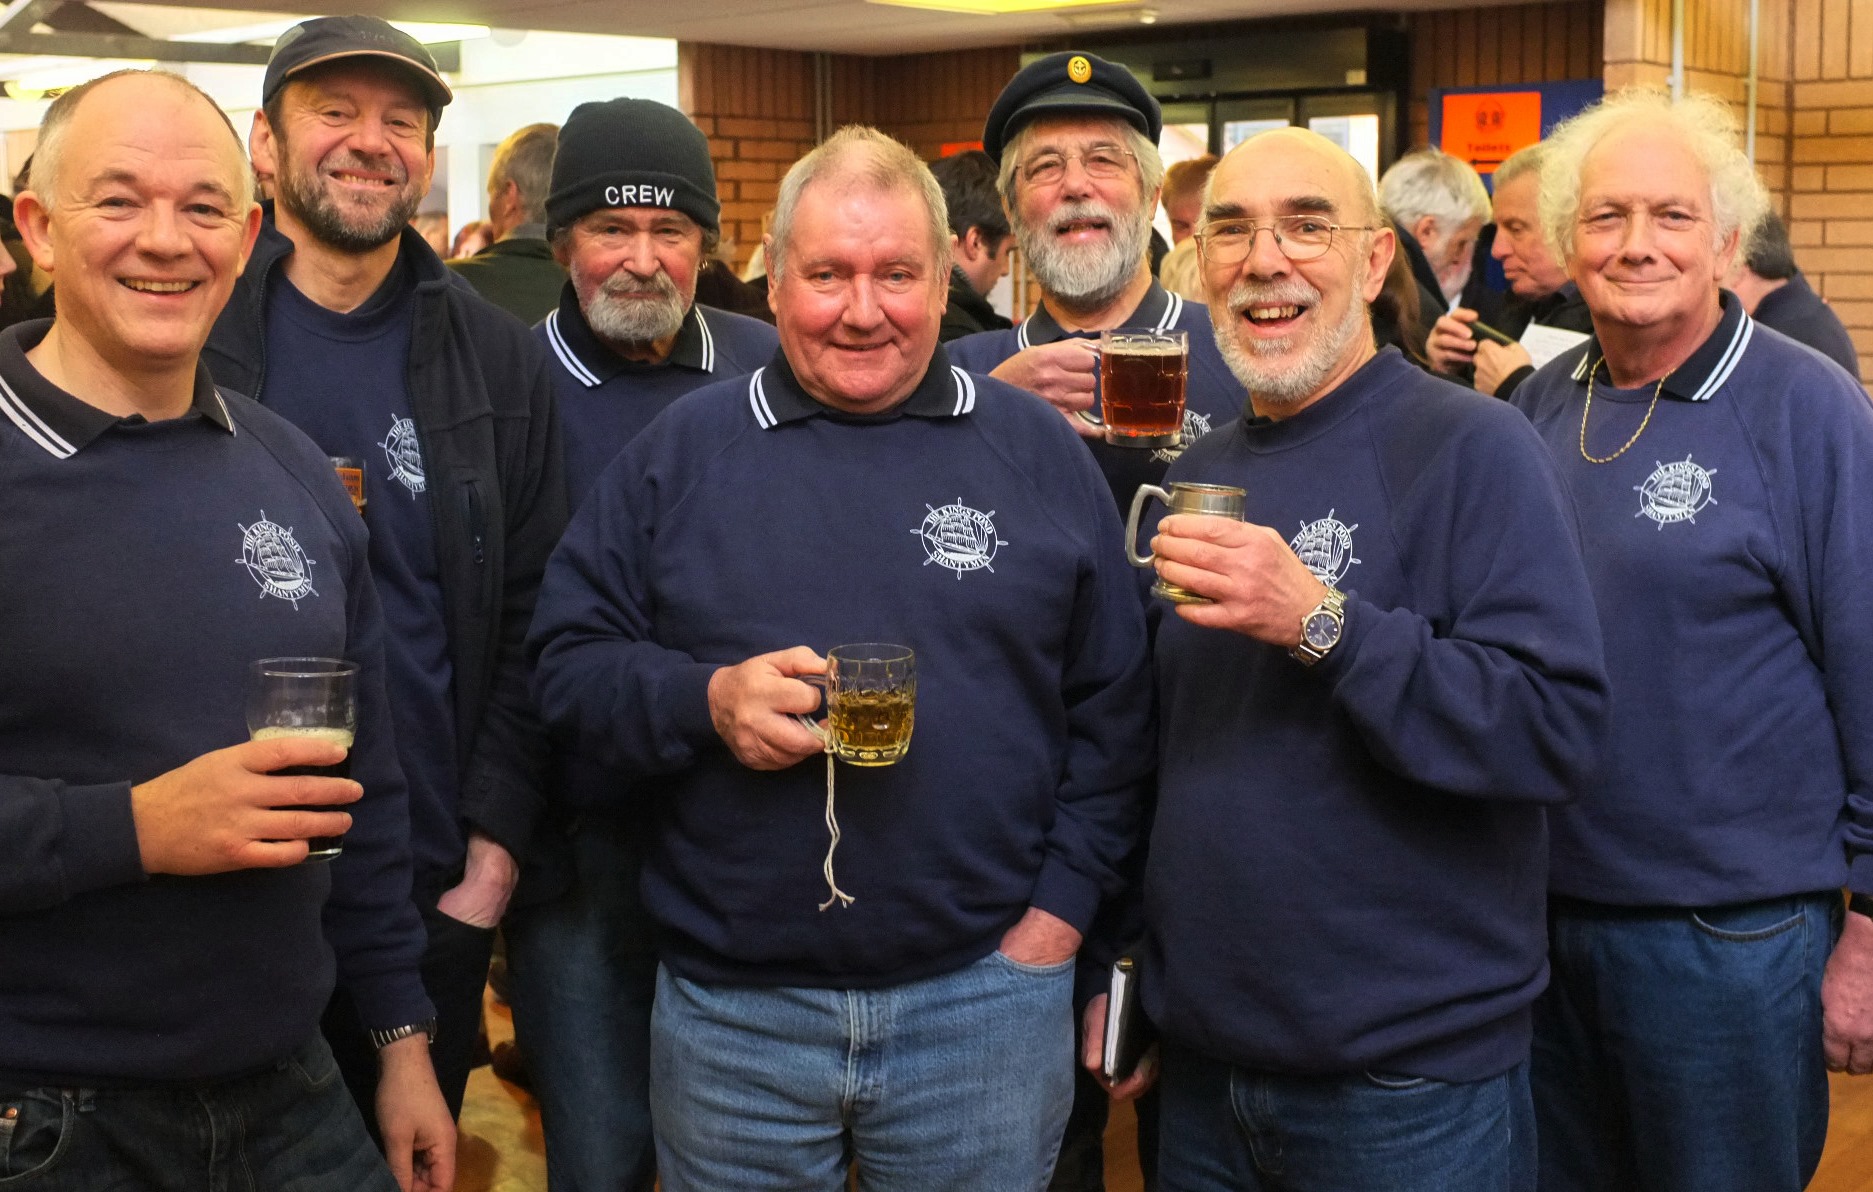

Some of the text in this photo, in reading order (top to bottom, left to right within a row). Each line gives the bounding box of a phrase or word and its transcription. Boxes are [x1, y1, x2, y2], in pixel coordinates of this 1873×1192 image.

[605, 184, 675, 207] CREW
[395, 467, 426, 491] SHANTYM
[926, 505, 995, 535] THE KINGS POND
[245, 522, 301, 552] THE KINGS POND
[1310, 519, 1338, 530] KINGS
[1336, 526, 1351, 550] POND
[931, 550, 990, 569] SHANTYMEN
[263, 576, 312, 598] SHANTYMEN
